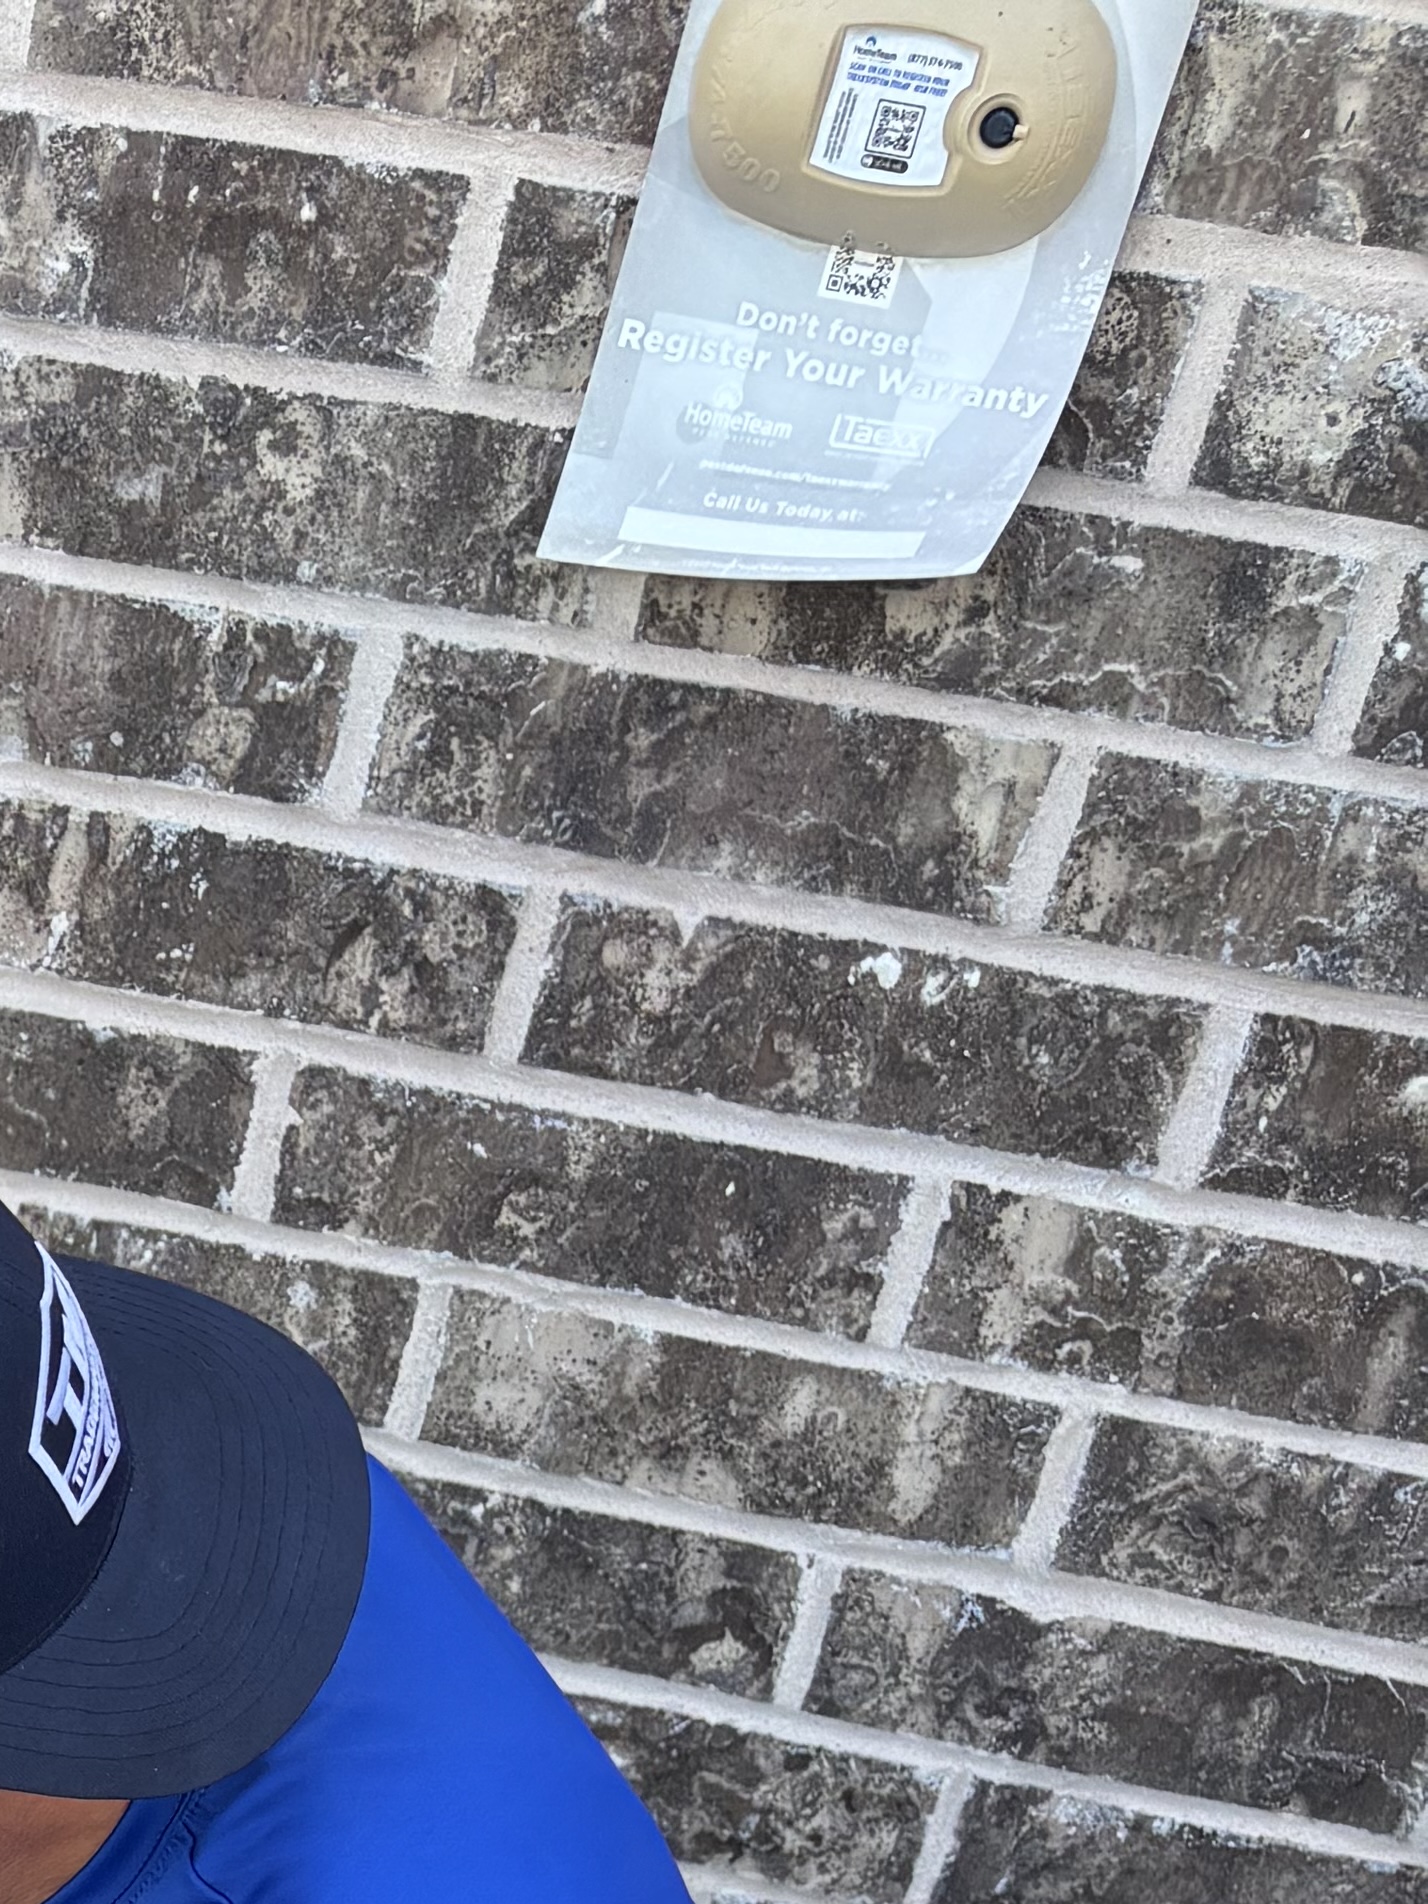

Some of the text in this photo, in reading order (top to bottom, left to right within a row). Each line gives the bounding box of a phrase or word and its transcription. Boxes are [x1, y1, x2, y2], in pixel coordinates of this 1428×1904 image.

[736, 301, 820, 340] Don't
[617, 318, 1049, 419] Register Your Warranty
[684, 402, 793, 441] HomeTeam
[703, 492, 741, 511] Call
[745, 496, 769, 514] Us
